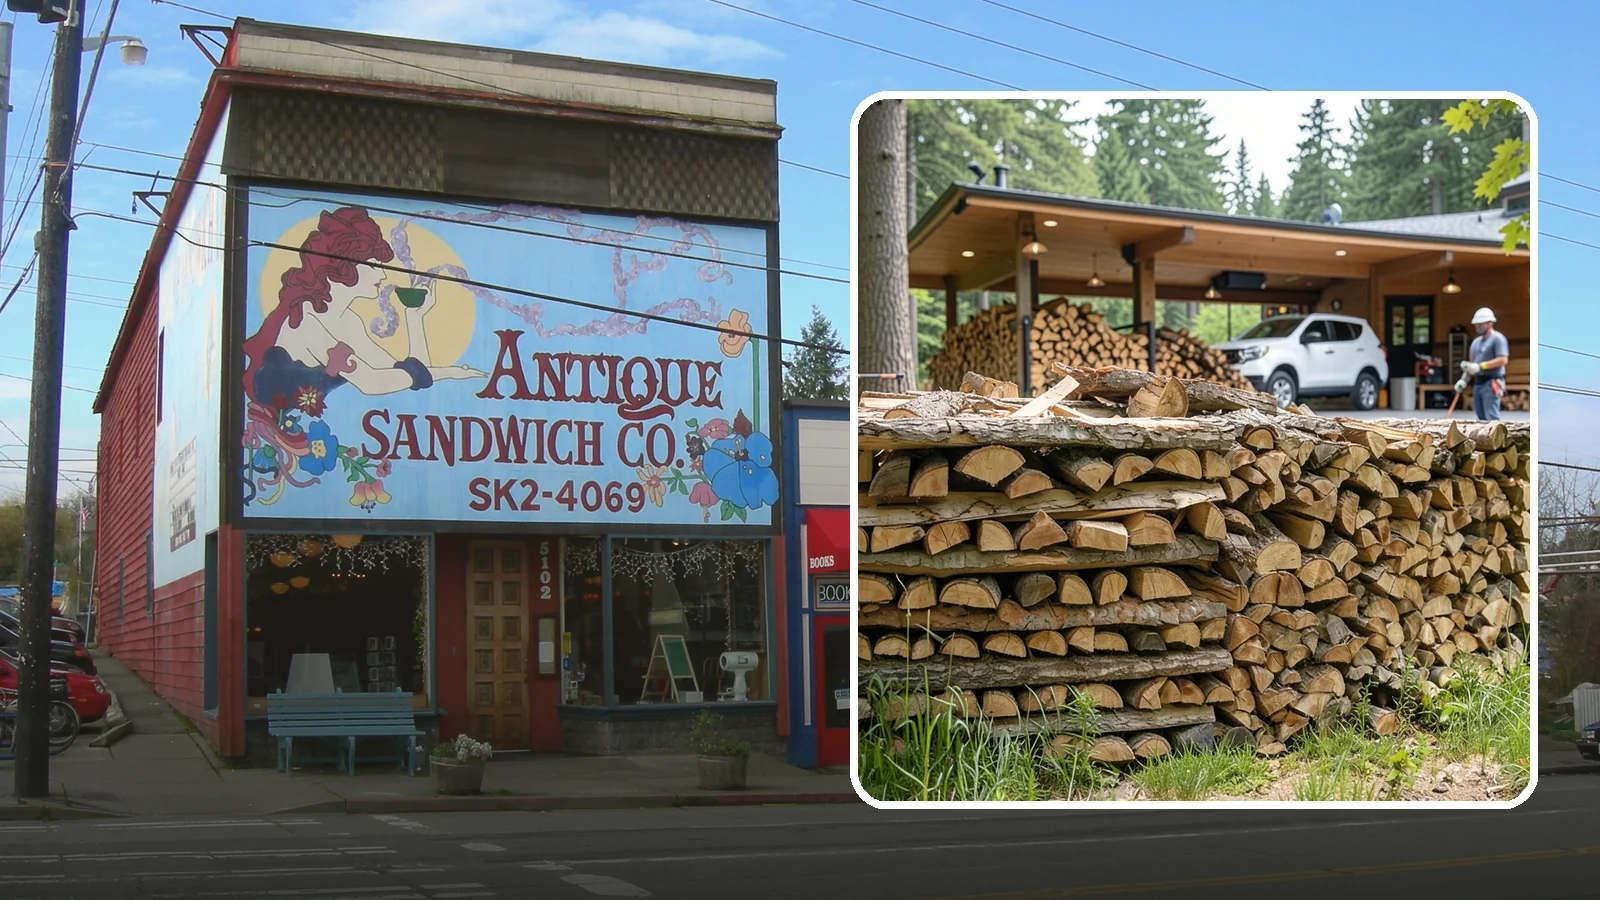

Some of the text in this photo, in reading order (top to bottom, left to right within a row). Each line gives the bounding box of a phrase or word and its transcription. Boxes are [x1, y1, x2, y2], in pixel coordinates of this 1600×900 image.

[477, 329, 723, 421] ANTIQUE
[361, 408, 685, 469] SANDWICH CO.
[468, 478, 645, 513] SK2-4069
[540, 541, 551, 600] 5102
[809, 555, 835, 569] BOOKS
